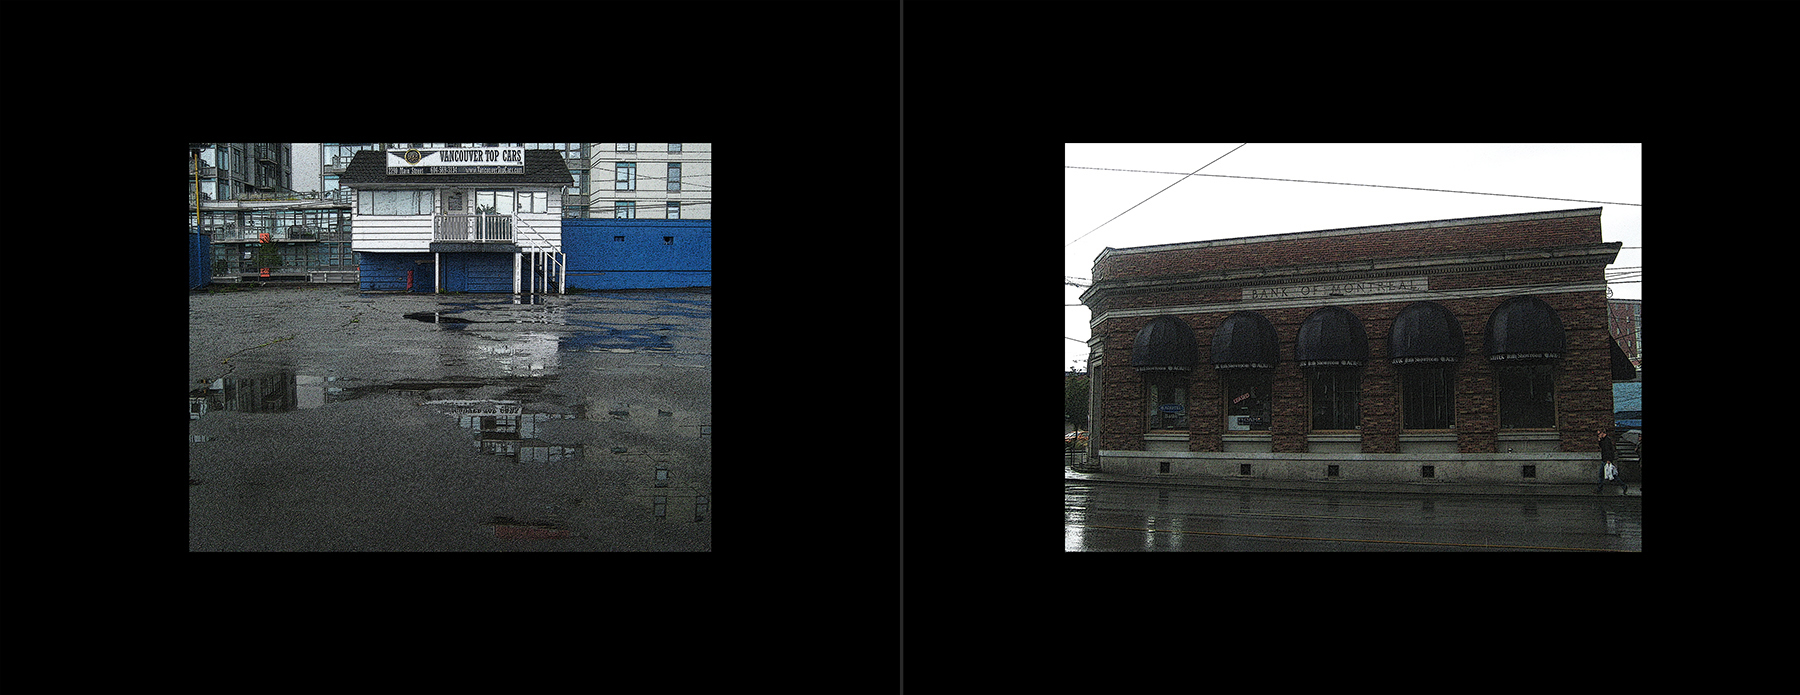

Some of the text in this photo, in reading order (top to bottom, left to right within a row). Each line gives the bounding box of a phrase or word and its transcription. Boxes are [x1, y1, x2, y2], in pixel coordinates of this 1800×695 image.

[439, 150, 522, 162] VANCOUVER TOP CARS
[1252, 280, 1420, 300] BANK OF MONTREAL
